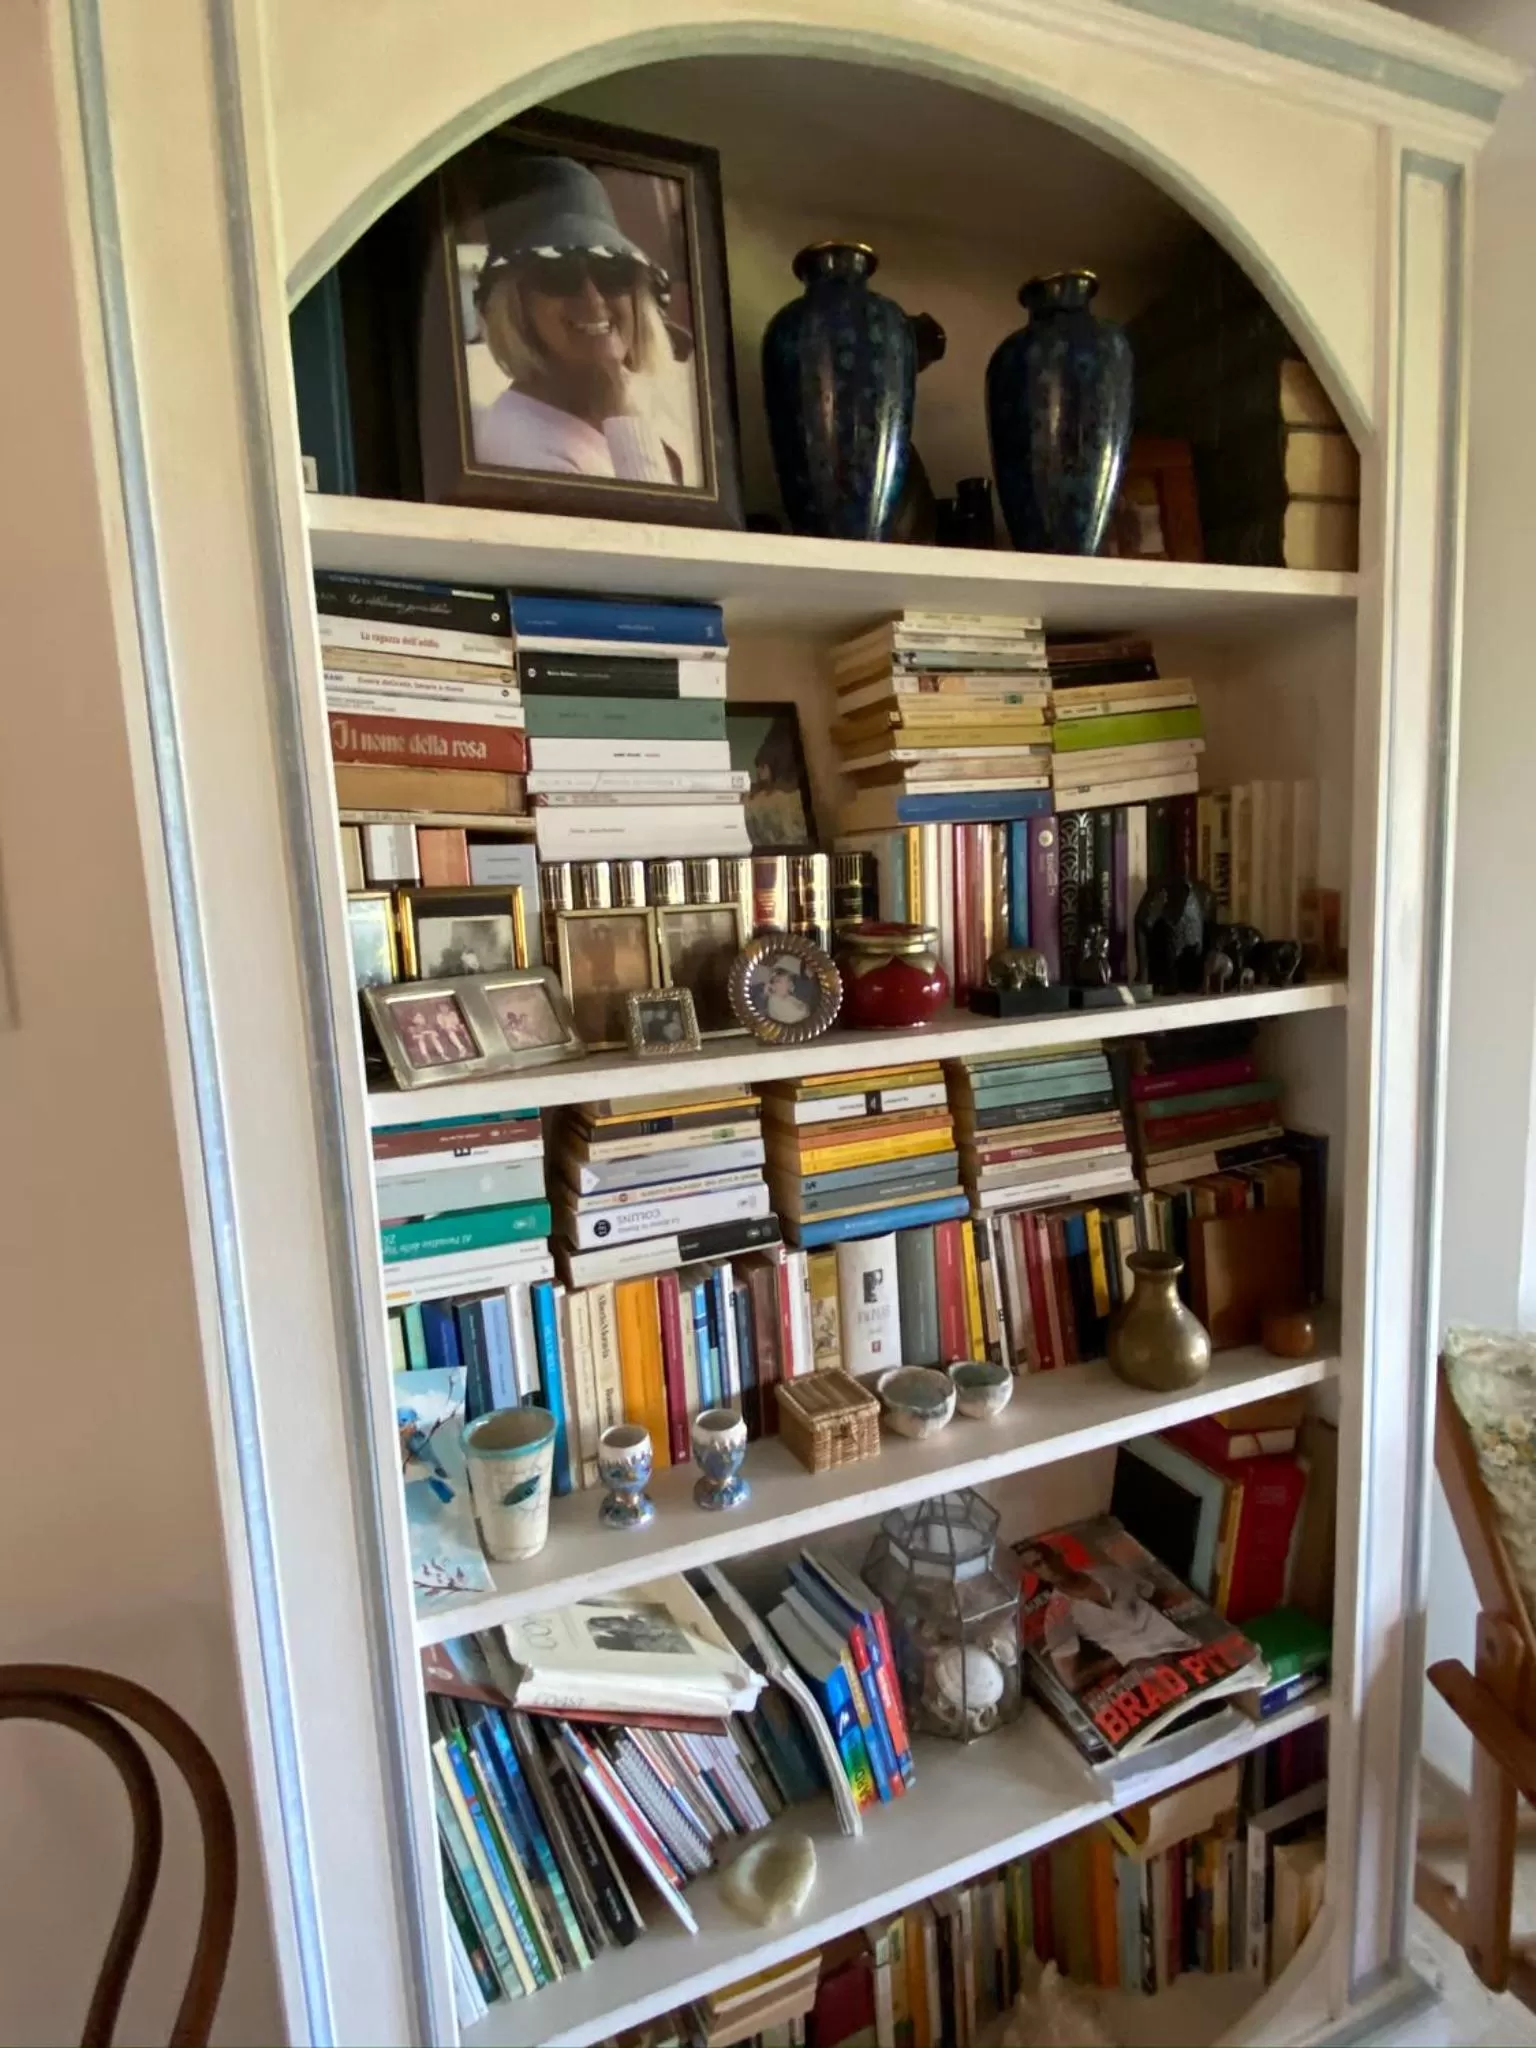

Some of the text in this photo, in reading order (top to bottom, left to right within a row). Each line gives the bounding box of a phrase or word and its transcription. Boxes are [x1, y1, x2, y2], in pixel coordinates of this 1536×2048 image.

[360, 731, 405, 753] nome
[408, 732, 449, 757] della
[452, 738, 488, 760] rosa
[1094, 1663, 1190, 1745] BRAD
